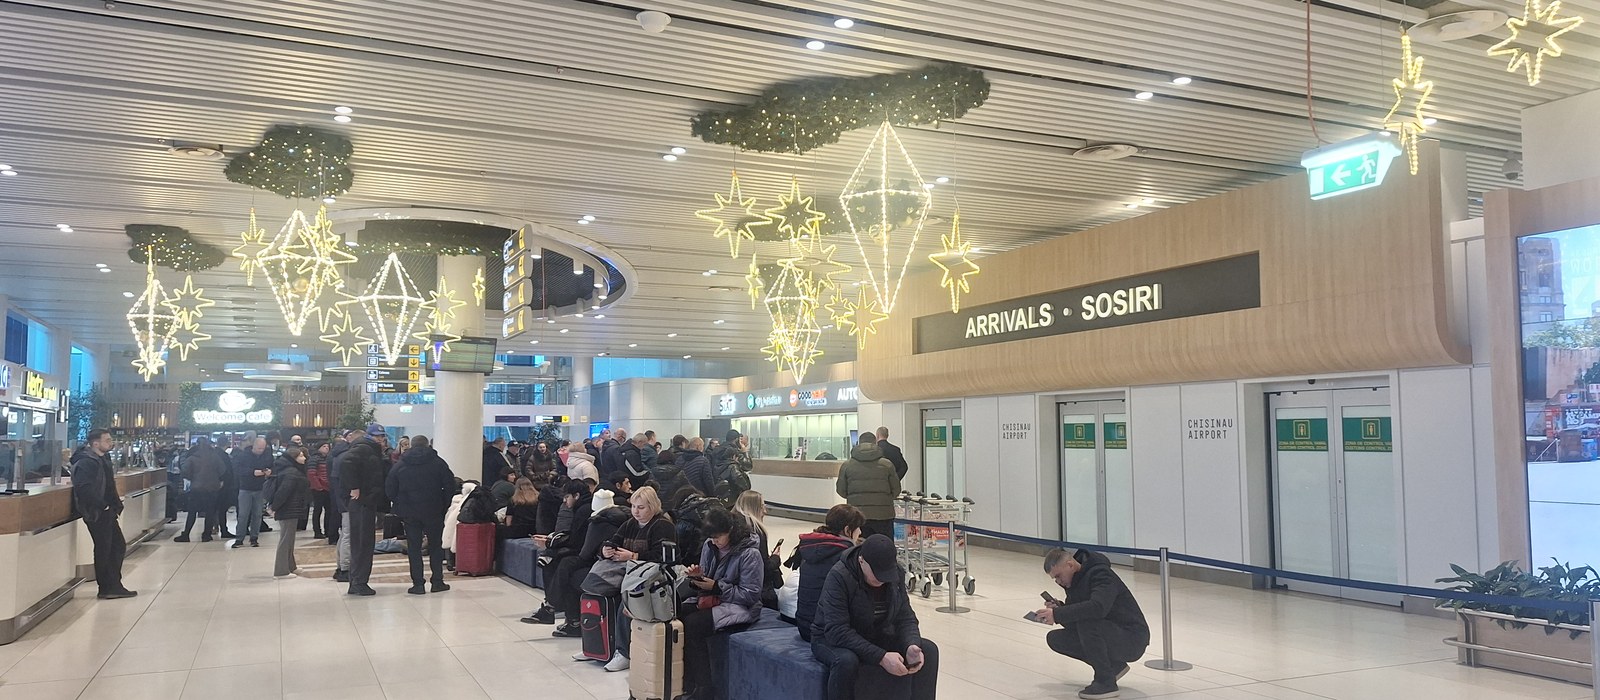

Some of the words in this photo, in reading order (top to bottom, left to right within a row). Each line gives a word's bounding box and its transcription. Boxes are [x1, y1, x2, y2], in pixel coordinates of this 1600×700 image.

[965, 303, 1053, 339] ARRIVALS
[1081, 283, 1162, 321] SOSIRI
[195, 411, 244, 422] Welcome
[1002, 423, 1032, 431] CHISINAU
[1187, 418, 1233, 429] CHISINAU
[1002, 431, 1028, 440] AIRPORT
[1188, 429, 1227, 440] AIRPORT
